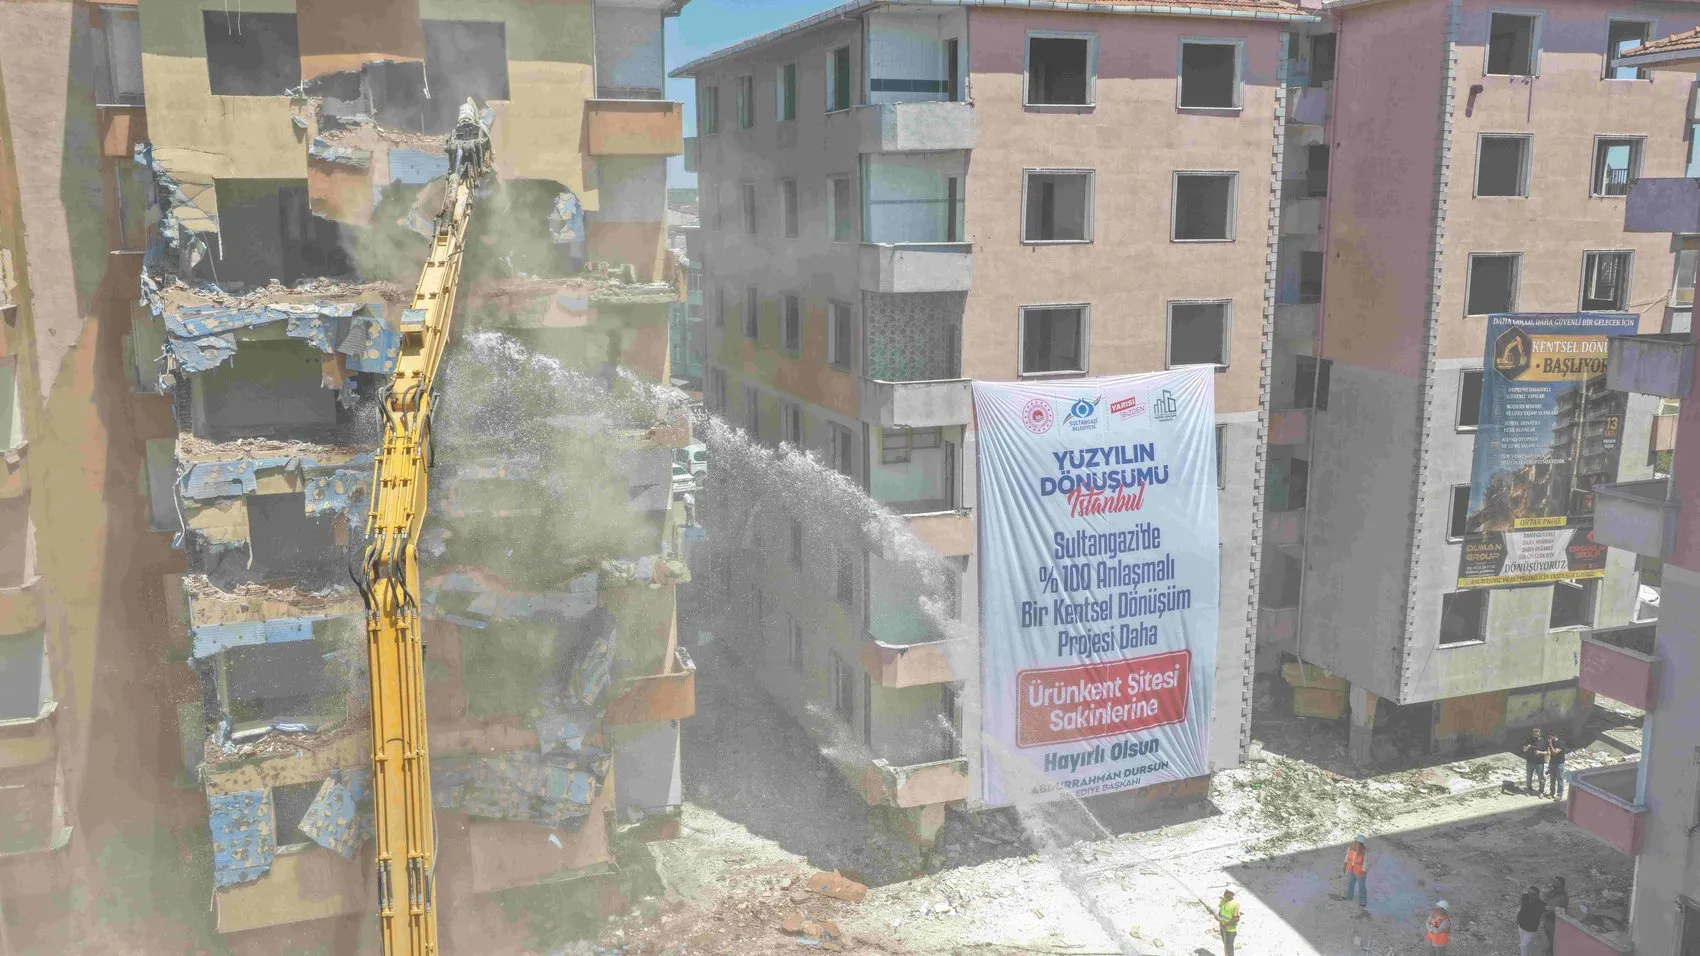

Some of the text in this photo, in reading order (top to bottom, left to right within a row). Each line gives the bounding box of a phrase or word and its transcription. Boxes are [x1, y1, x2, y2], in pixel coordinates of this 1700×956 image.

[1554, 317, 1582, 326] GÜVENLİ
[1582, 317, 1593, 326] BİR
[1621, 318, 1634, 327] İÇİN
[1532, 340, 1579, 353] KENTSEL
[1110, 399, 1135, 411] YARISI
[1607, 416, 1618, 430] 13
[1052, 442, 1155, 471] YÜZYILIN
[1040, 464, 1169, 497] DÖNÜŞÜMÜ
[1520, 517, 1561, 526] ORTAK PROJE
[1053, 521, 1161, 560] Sultangazi'de
[1466, 543, 1502, 551] DUMAN
[1096, 553, 1175, 591] Anlaşmalı
[1504, 560, 1566, 573] DÖNÜŞÜYORUZ
[1021, 585, 1191, 628] Bir Kentsel Dönüşüm
[1058, 621, 1158, 658] Projesi Daha
[1028, 664, 1180, 707] Ürünkent Sitesi
[1050, 697, 1158, 732] Sakinlerine
[1044, 738, 1160, 773] Hayırlı Olsun
[1123, 761, 1169, 778] DURSUN
